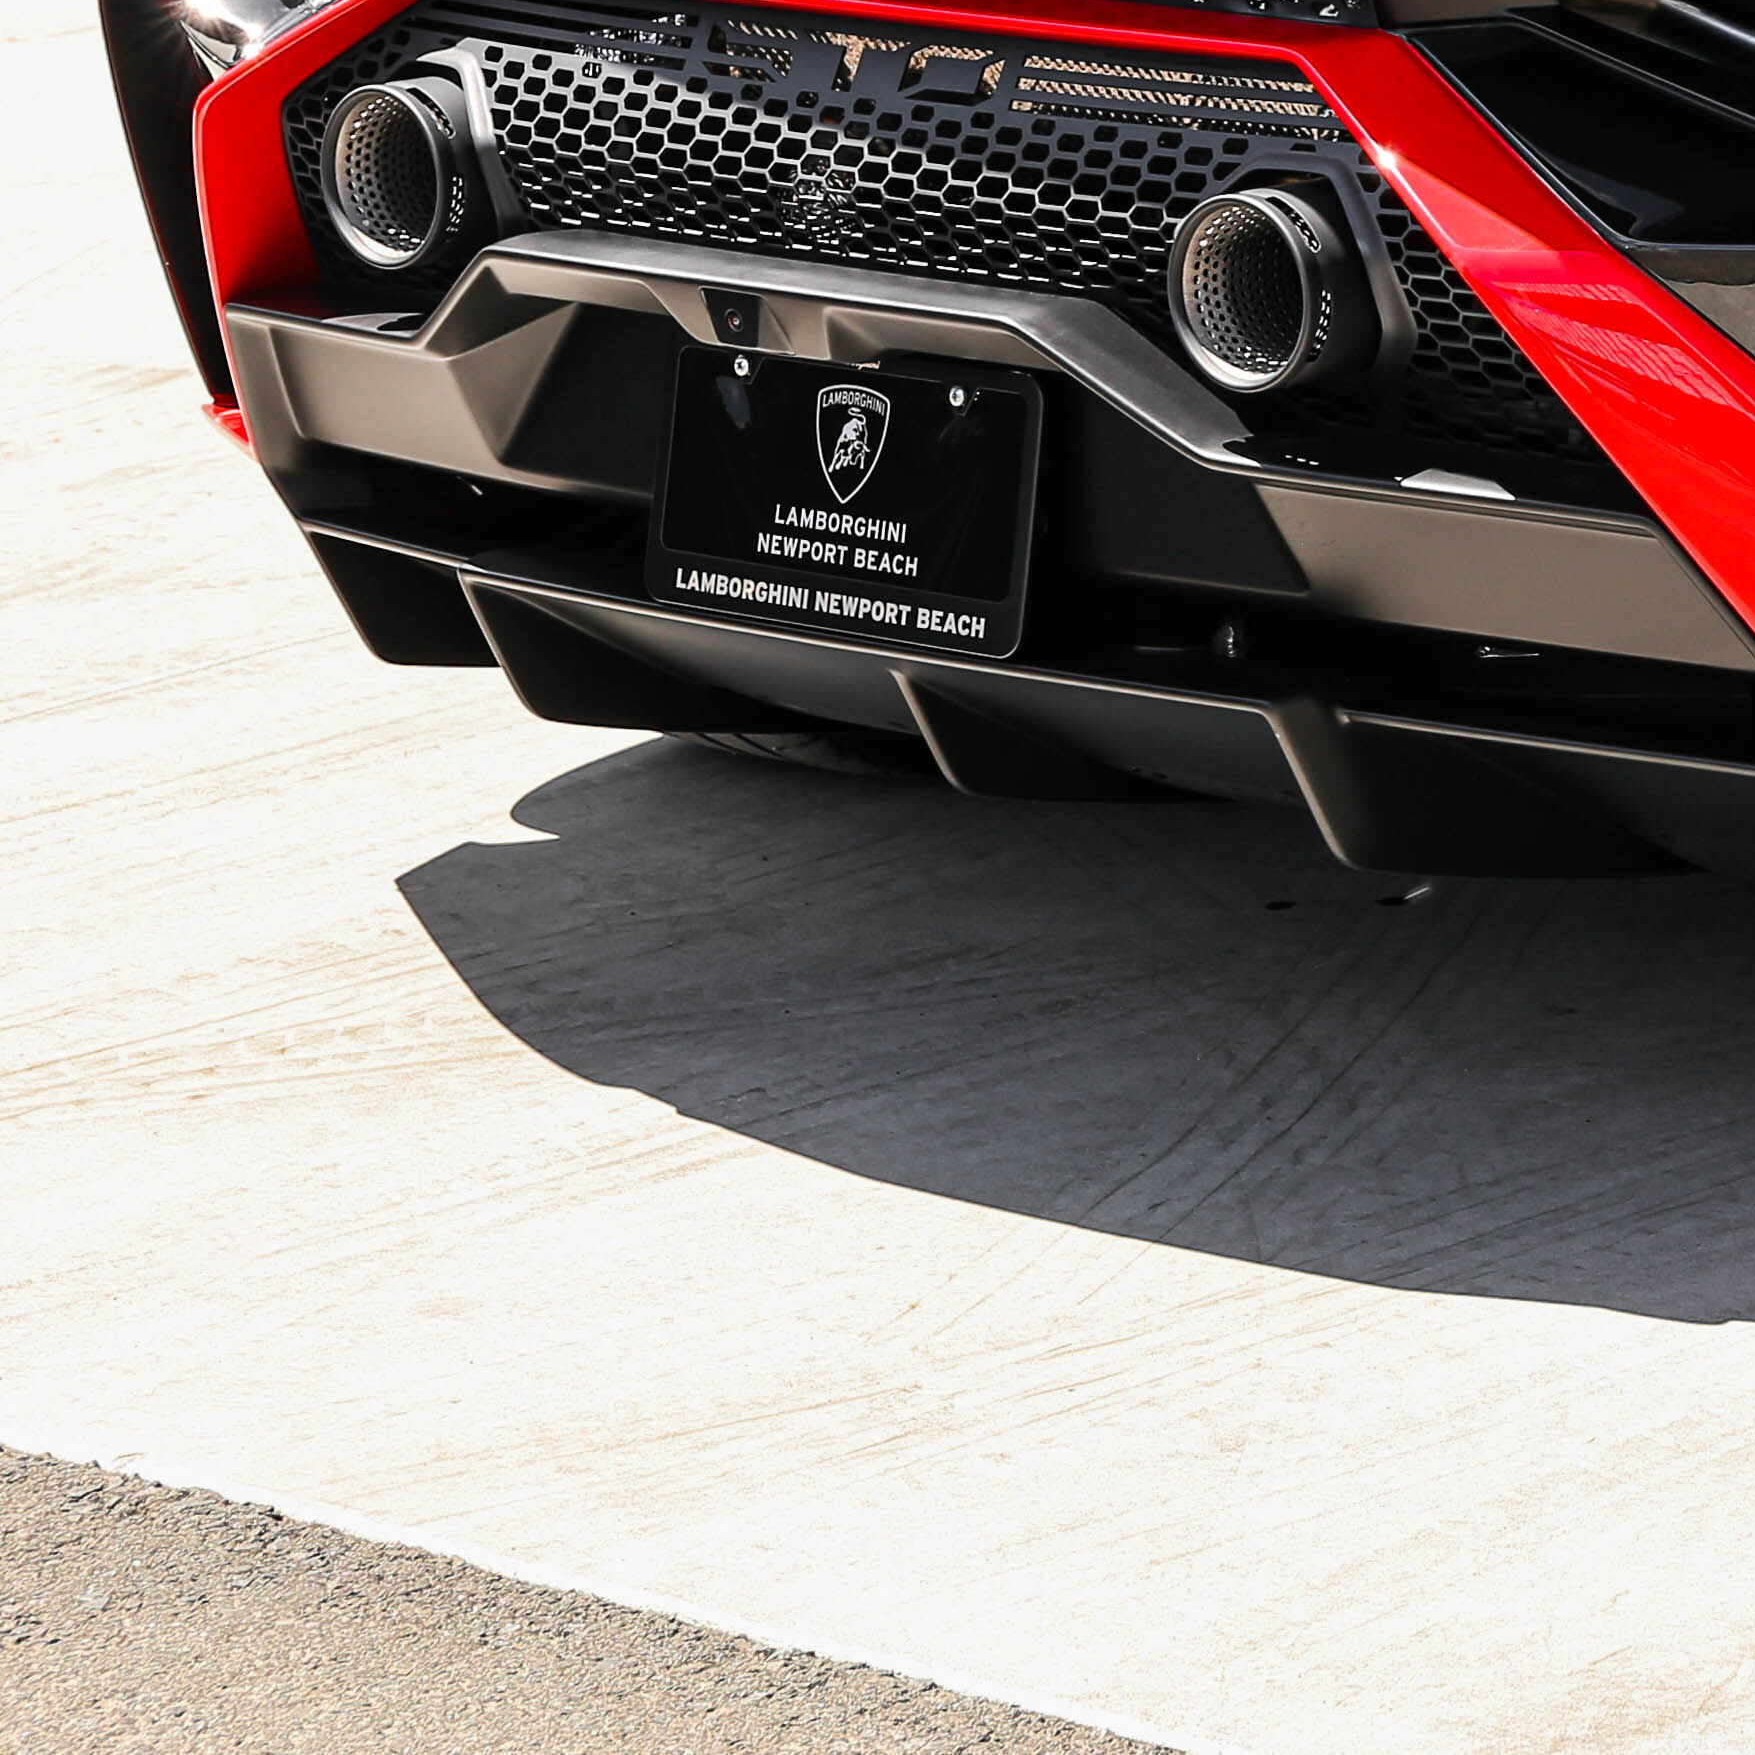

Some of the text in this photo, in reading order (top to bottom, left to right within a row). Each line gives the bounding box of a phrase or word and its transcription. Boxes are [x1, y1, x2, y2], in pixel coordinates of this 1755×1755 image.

[702, 19, 1006, 107] STO
[821, 389, 886, 416] LAMBORGHINI
[774, 503, 908, 544] LAMBORGHINI
[757, 532, 919, 577] NEWPORT BEACH
[675, 567, 986, 639] LAMBORGHINI NEWPORT BEACH
